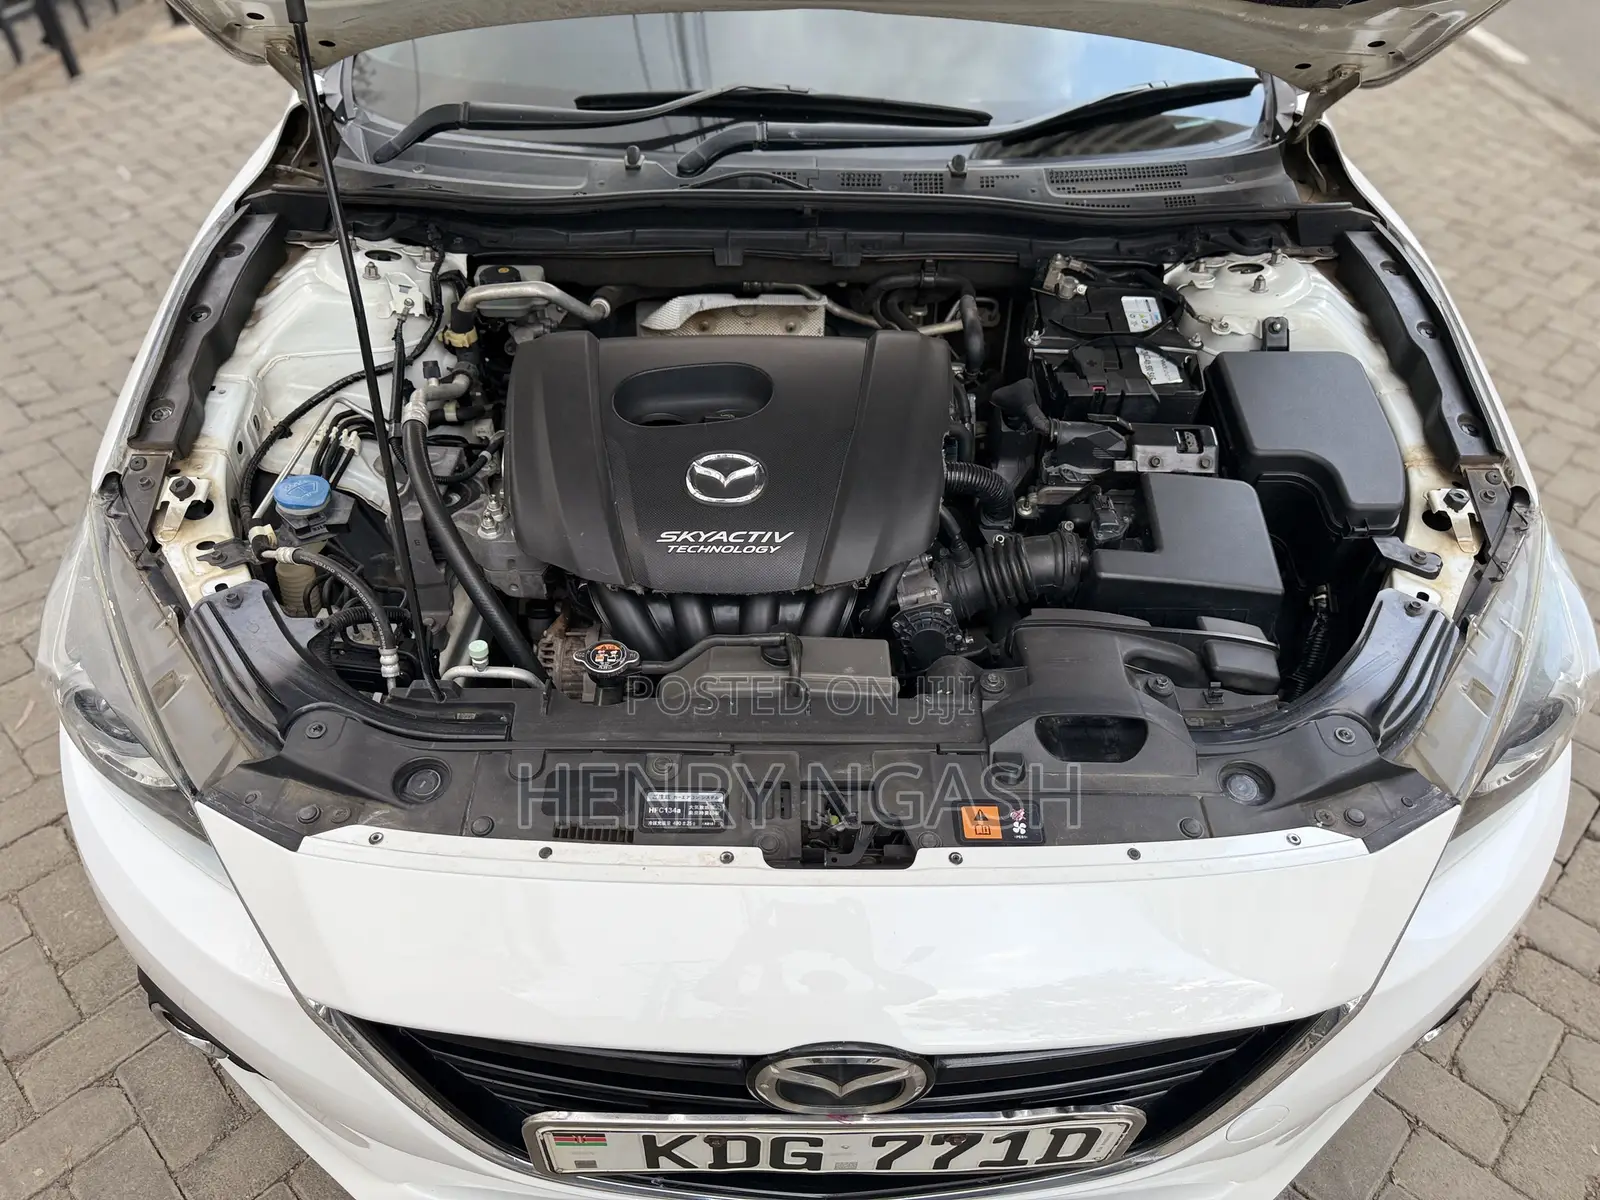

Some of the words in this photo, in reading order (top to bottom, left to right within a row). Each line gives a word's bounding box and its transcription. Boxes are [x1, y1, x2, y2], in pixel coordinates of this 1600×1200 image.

[656, 530, 794, 543] SKYACTIV
[667, 545, 782, 554] TECHNOLOGY
[648, 806, 681, 814] HFC134a
[642, 1134, 824, 1171] KDG
[871, 1127, 1102, 1170] 771D
